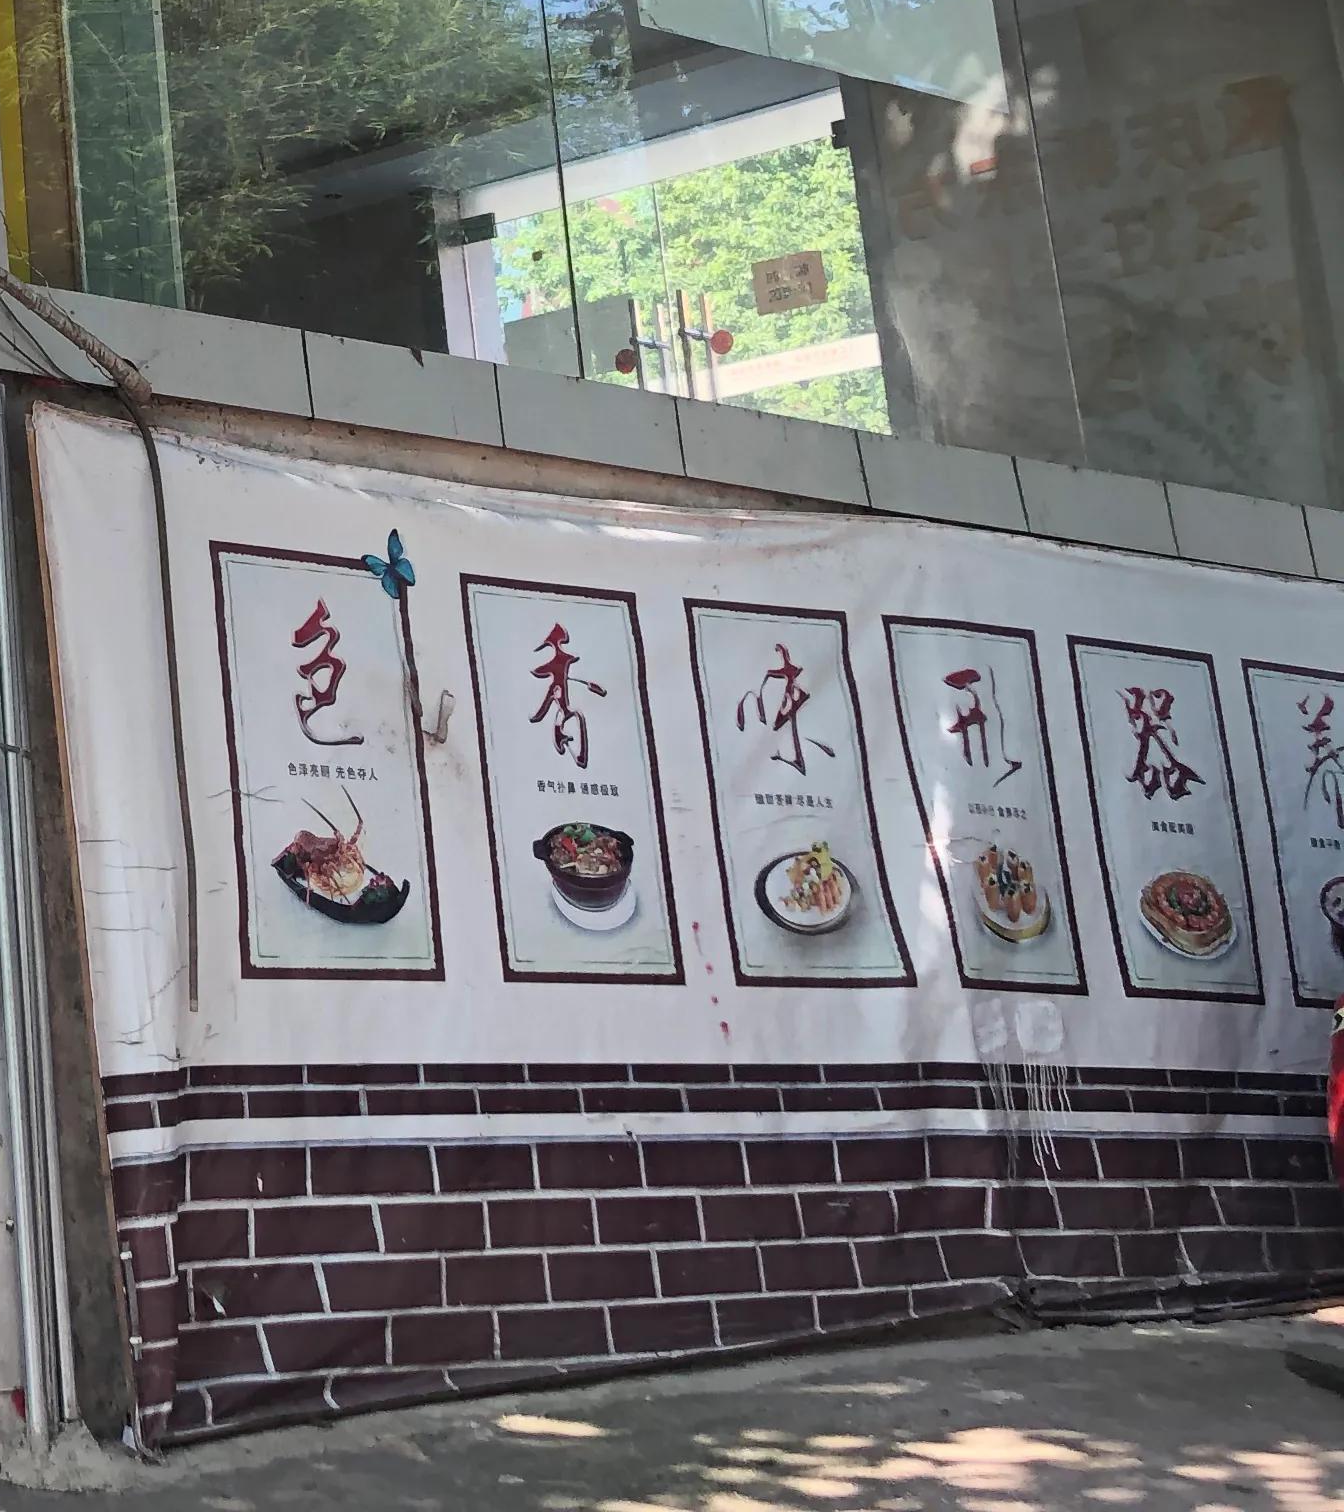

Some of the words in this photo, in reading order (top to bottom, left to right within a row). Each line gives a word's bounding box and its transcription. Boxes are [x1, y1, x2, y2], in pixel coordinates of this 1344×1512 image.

[291, 598, 364, 745] 色
[529, 622, 607, 769] 香
[736, 643, 835, 776] 味
